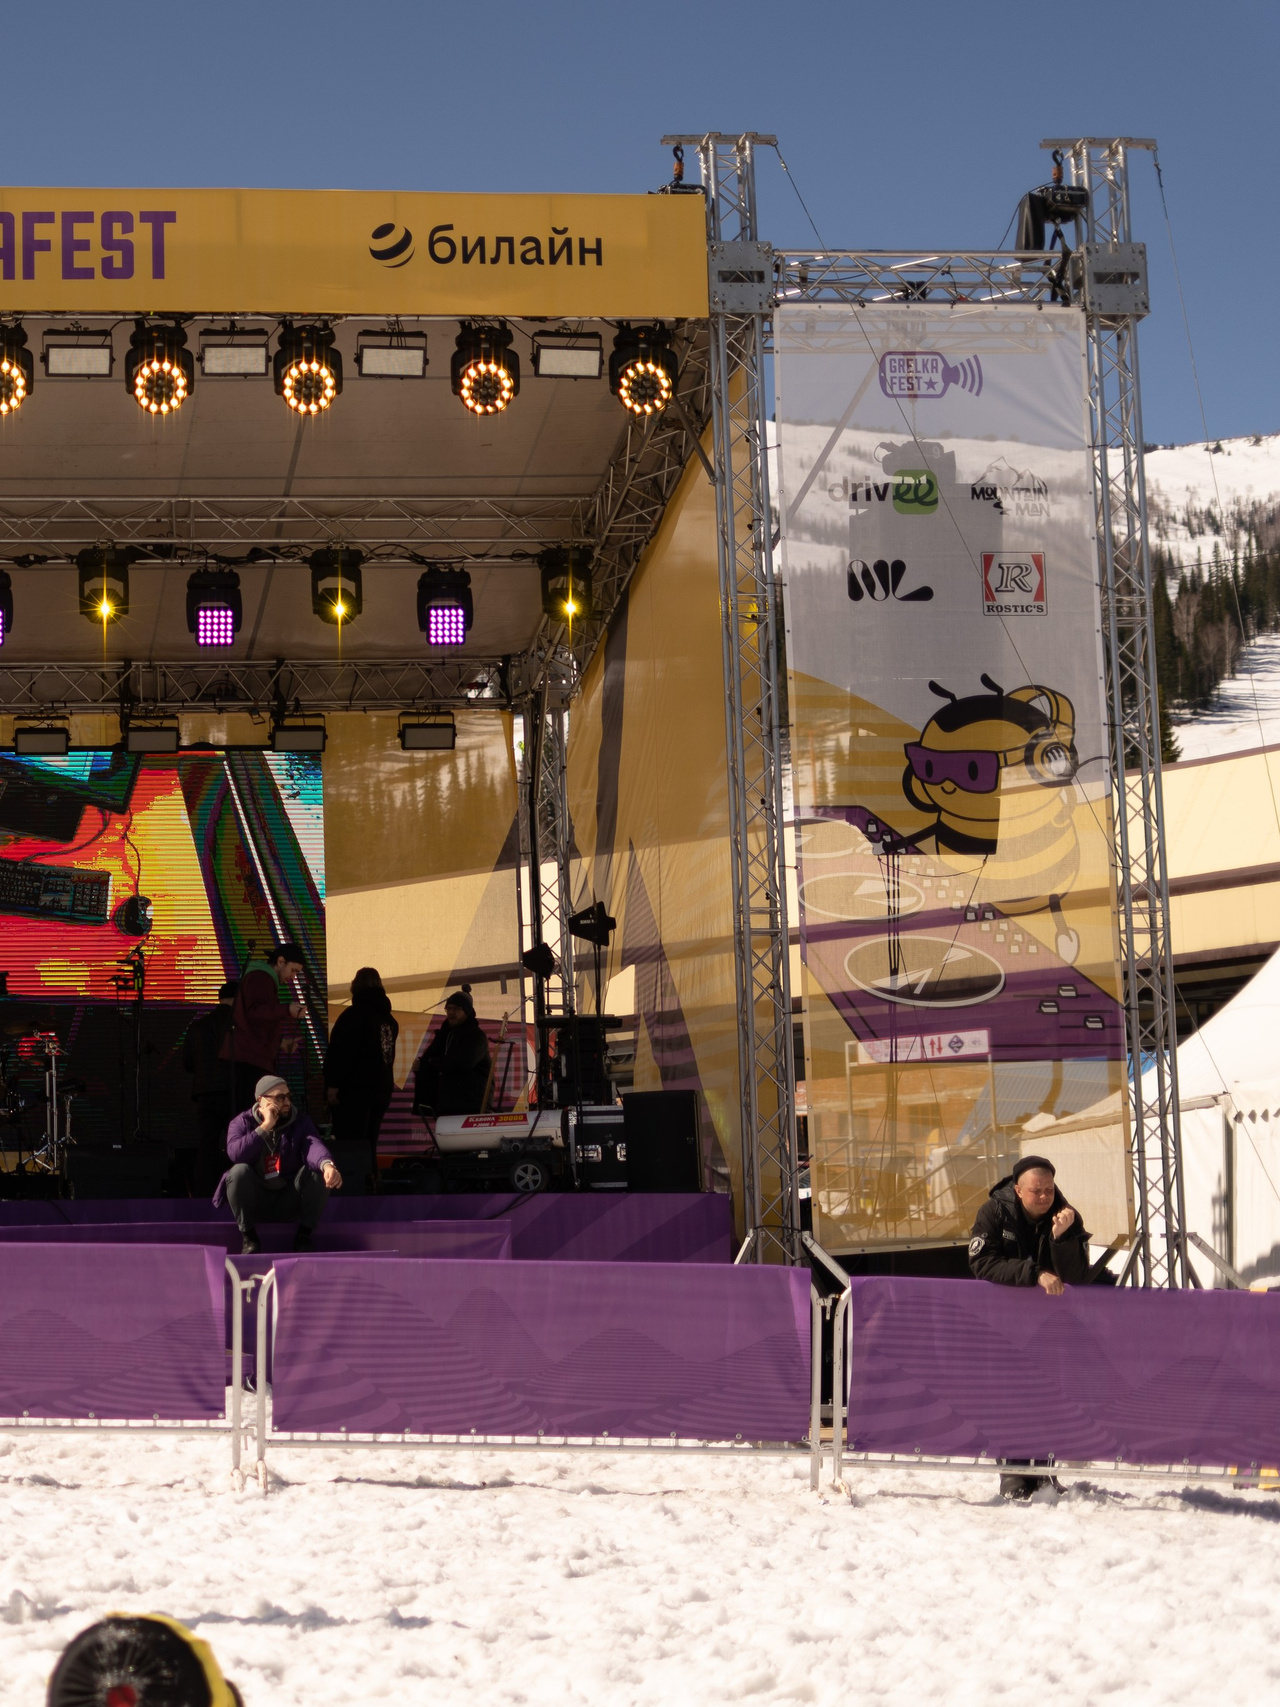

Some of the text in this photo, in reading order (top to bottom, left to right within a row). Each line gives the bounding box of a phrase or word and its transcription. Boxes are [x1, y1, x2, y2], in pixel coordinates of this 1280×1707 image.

[427, 223, 603, 266] билайн
[889, 358, 939, 374] GRELKA
[889, 376, 923, 391] FEST
[828, 475, 939, 507] drivee
[971, 485, 1049, 501] MOUNTAIN
[1015, 502, 1051, 517] MAN
[985, 604, 1045, 613] ROSTIC'S
